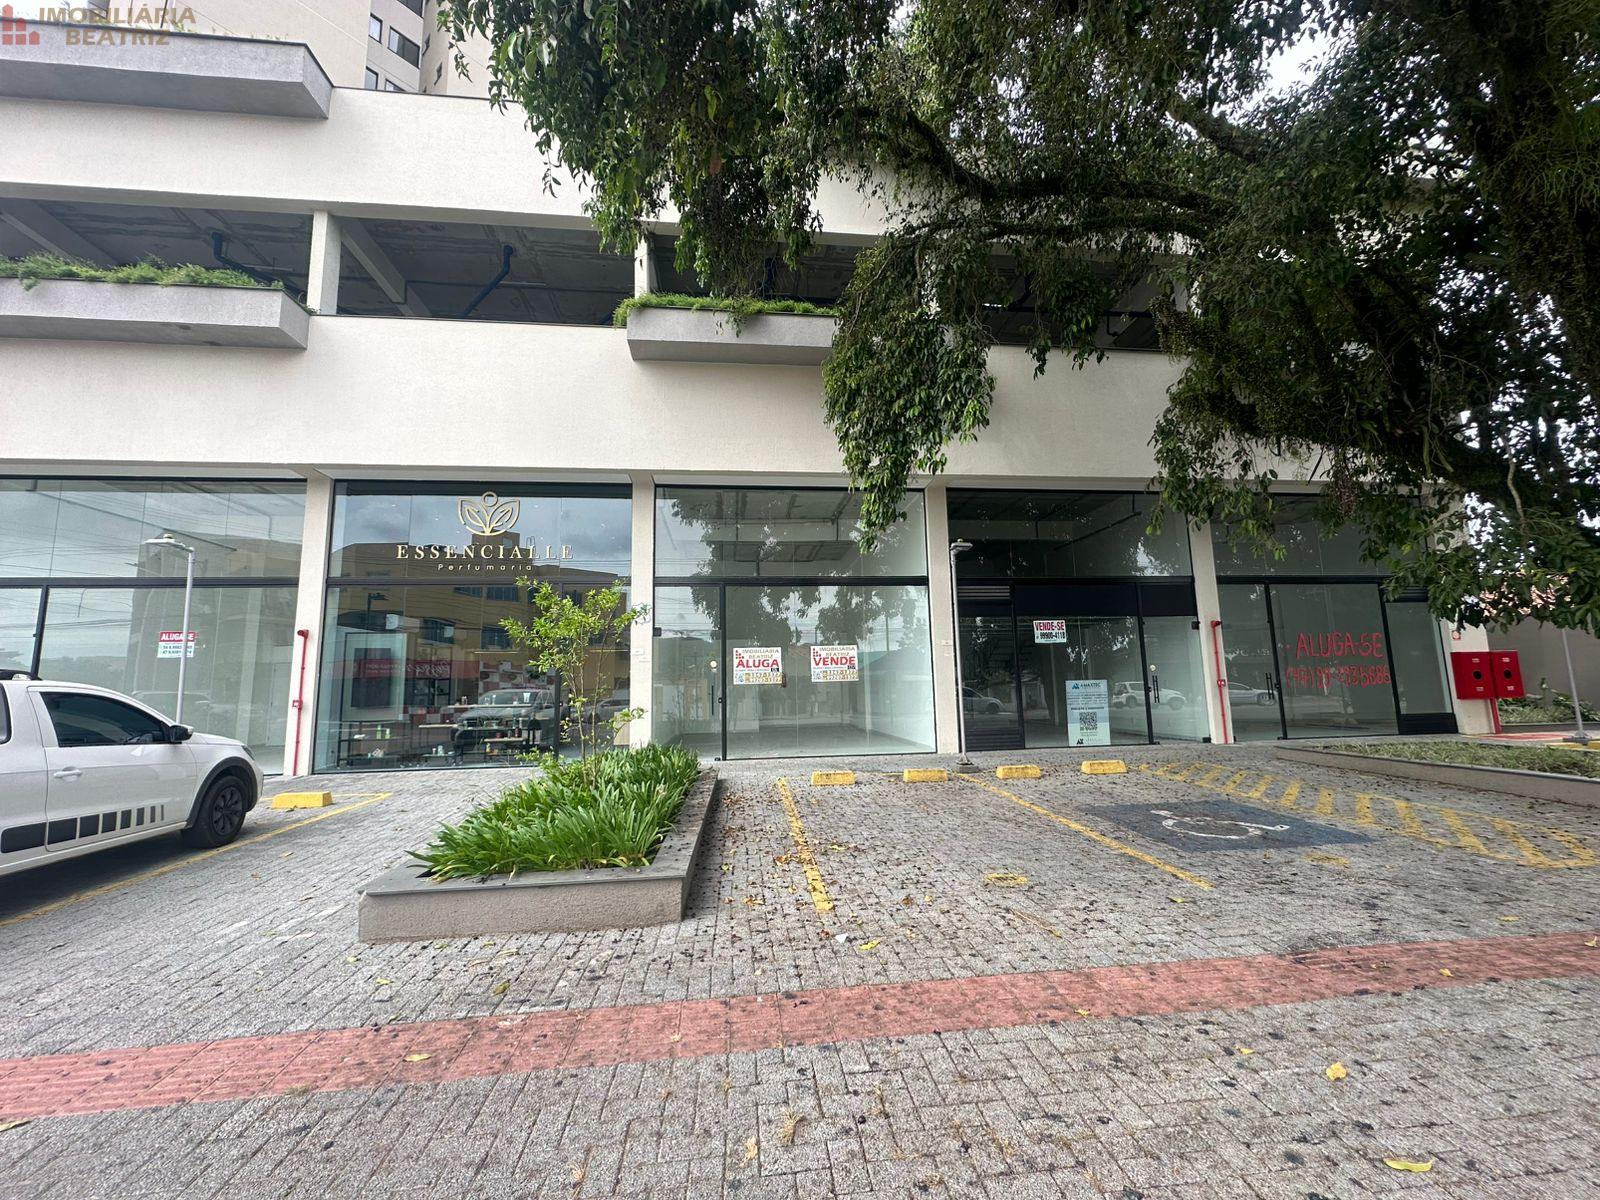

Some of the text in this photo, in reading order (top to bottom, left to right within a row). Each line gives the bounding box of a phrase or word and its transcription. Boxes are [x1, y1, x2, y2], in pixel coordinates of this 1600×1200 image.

[395, 544, 575, 560] ESSENCIALLE
[437, 563, 533, 572] Perfumaria
[1034, 621, 1065, 631] VENDE-SE
[160, 633, 195, 641] ALUGAE
[1296, 632, 1384, 659] ALUGA-SE
[736, 659, 779, 668] ALUGA
[813, 656, 856, 666] VENDE
